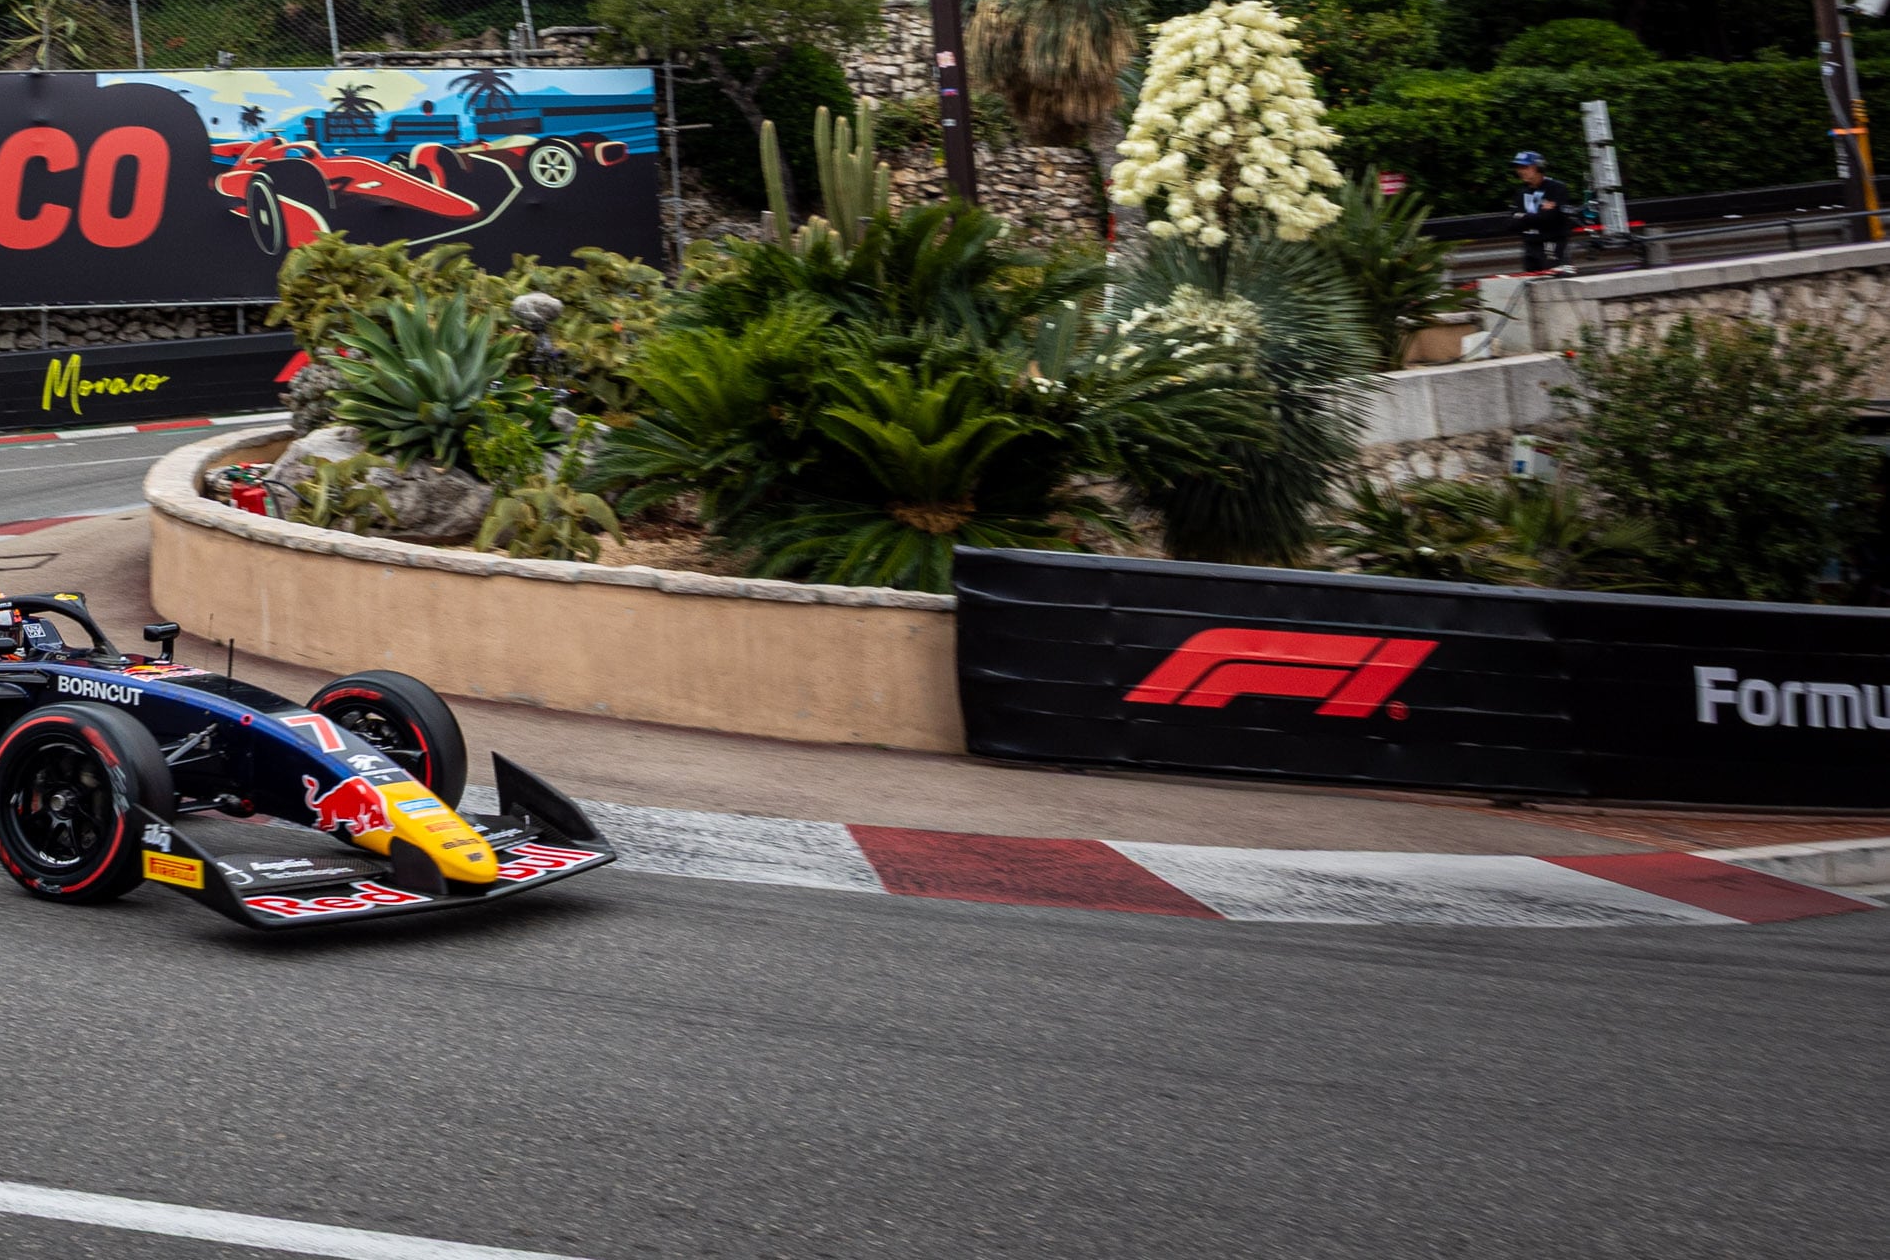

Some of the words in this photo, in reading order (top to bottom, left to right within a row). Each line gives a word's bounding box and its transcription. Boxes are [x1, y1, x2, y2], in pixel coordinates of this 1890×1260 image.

[41, 353, 170, 415] Monaco
[57, 675, 144, 706] BORNCUT
[279, 713, 347, 754] 7
[148, 856, 198, 882] PIRELLI
[242, 880, 433, 918] Red
